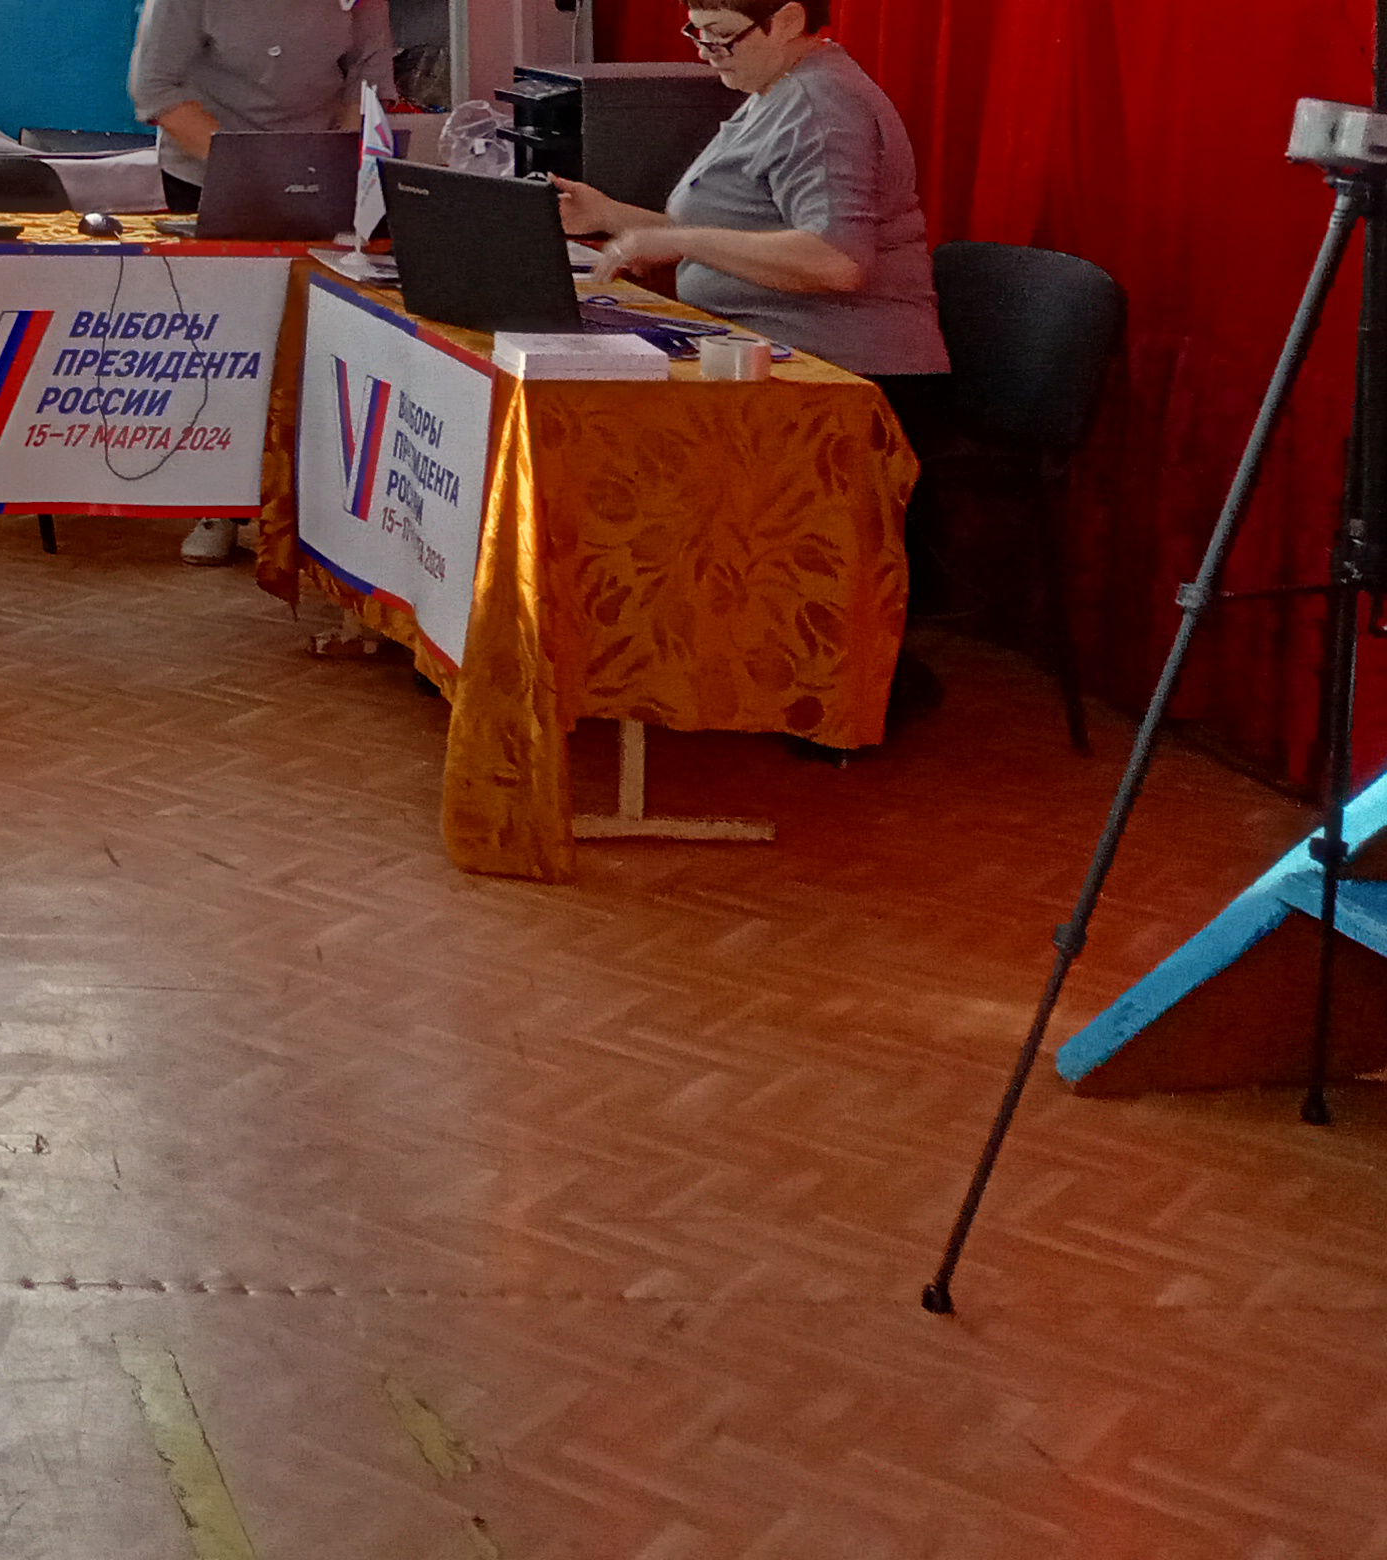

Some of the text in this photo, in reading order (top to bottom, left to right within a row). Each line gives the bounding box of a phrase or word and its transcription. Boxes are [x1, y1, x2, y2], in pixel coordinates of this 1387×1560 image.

[69, 310, 220, 341] ВЫБОРЫ
[52, 348, 262, 382] ПРЕЗИДЕНТА
[35, 386, 172, 417] РОССИИ
[90, 424, 173, 450] МАРТА
[176, 426, 232, 451] 2024
